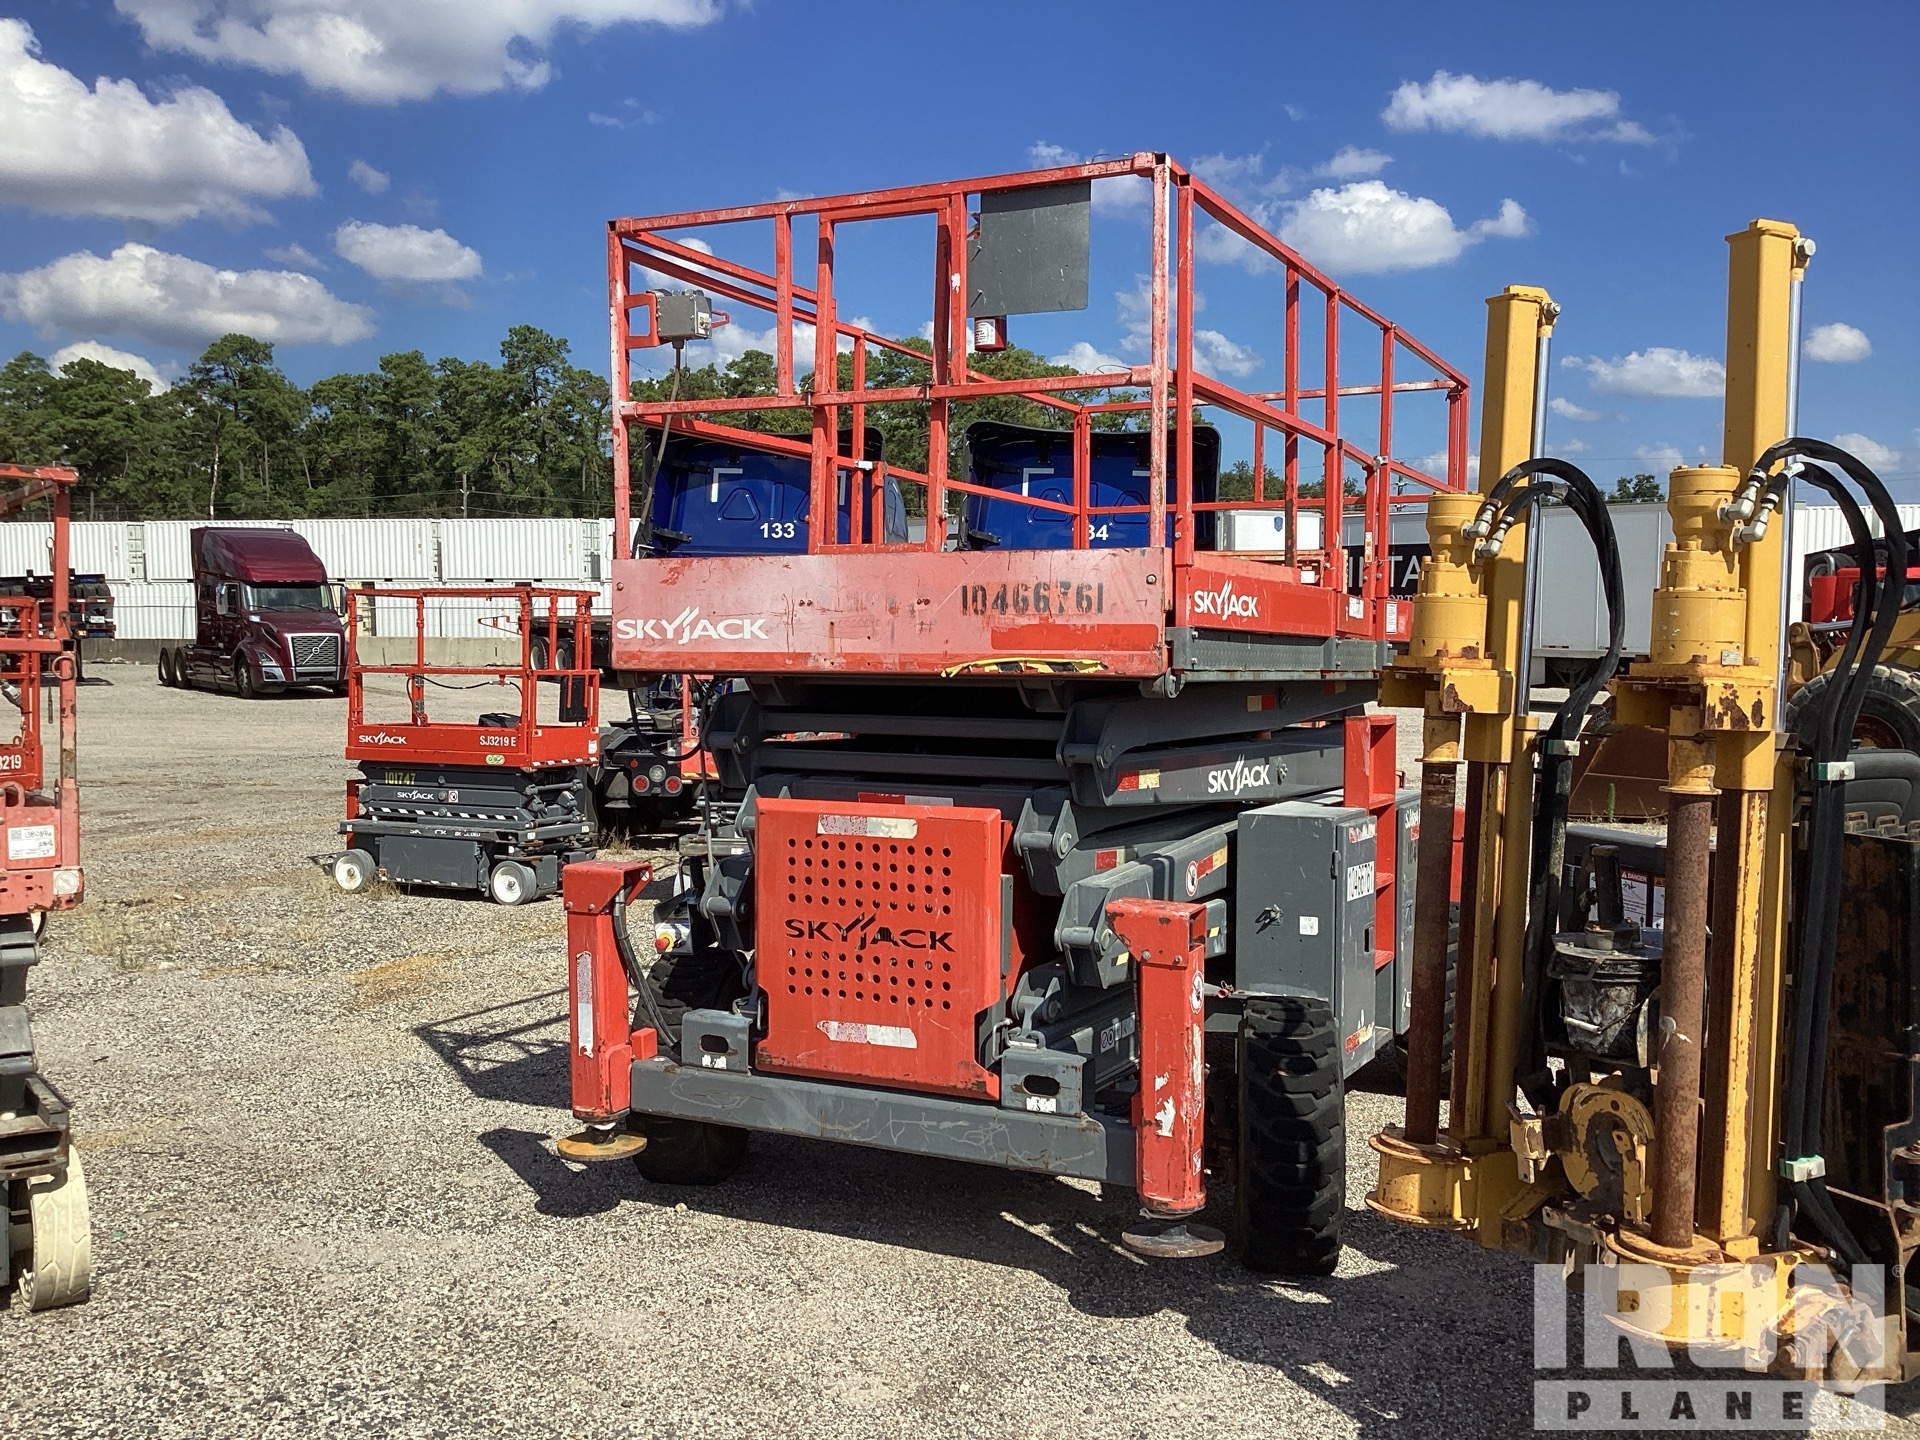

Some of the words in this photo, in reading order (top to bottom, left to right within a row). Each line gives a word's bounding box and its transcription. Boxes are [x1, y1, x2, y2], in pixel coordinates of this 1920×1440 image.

[760, 523, 795, 539] 133
[1193, 579, 1259, 621] SKYJACK
[616, 605, 770, 646] SKYJACK
[358, 731, 407, 745] SKYJACK
[479, 735, 510, 747] SJ3219
[510, 736, 517, 747] E
[1207, 754, 1271, 795] SKYJACK
[396, 790, 435, 800] SKYJACK
[1627, 873, 1647, 882] DANGER
[784, 912, 956, 952] SKYJACK
